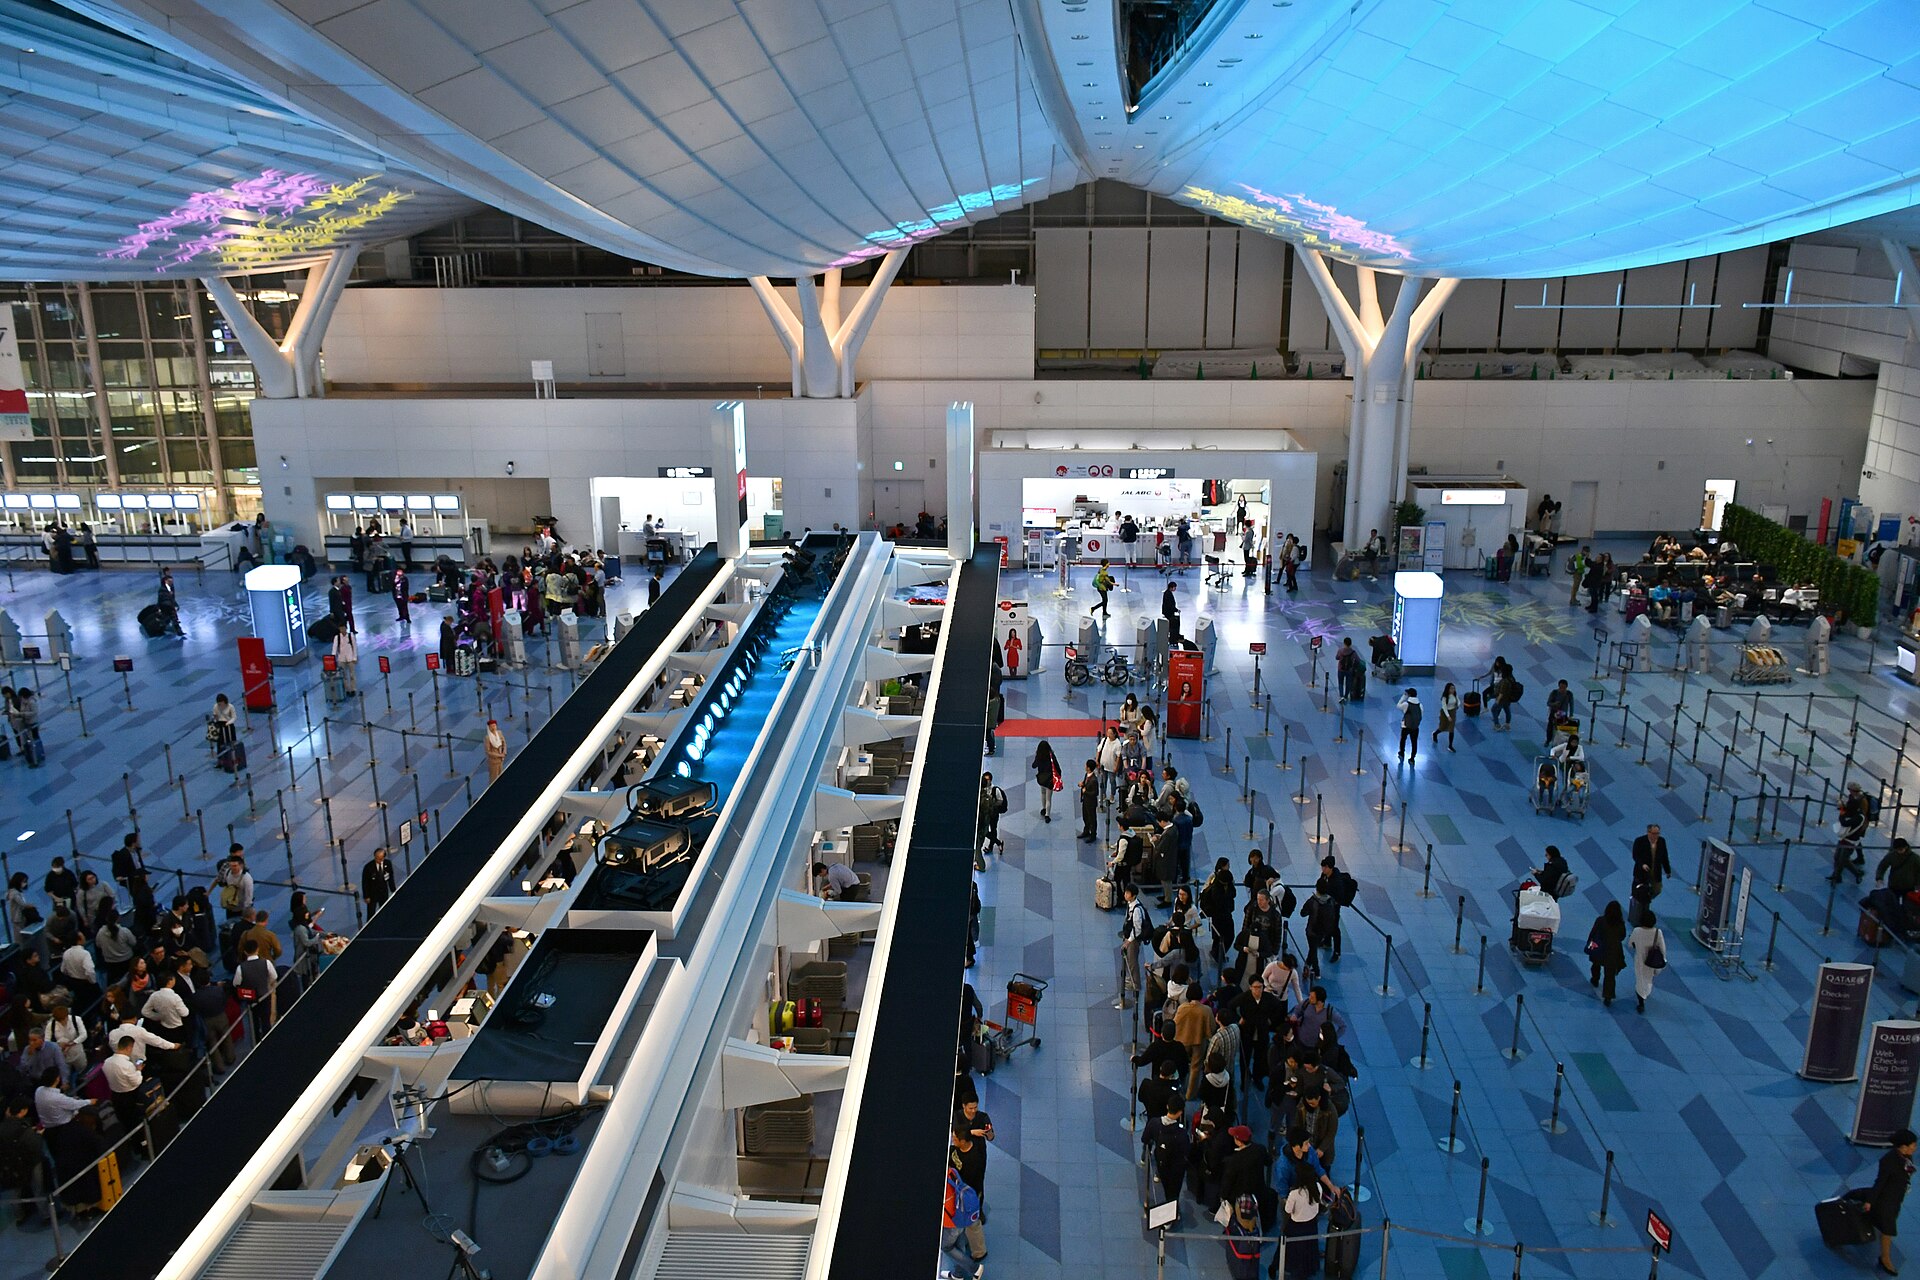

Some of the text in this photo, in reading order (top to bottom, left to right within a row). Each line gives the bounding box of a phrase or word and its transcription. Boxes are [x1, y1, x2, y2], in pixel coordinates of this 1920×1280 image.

[1826, 974, 1856, 983] QATAR
[1880, 1033, 1911, 1042] QATAR
[1875, 1049, 1894, 1057] Web
[1873, 1056, 1908, 1065] Check-in
[1872, 1064, 1909, 1073] Bag Drop
